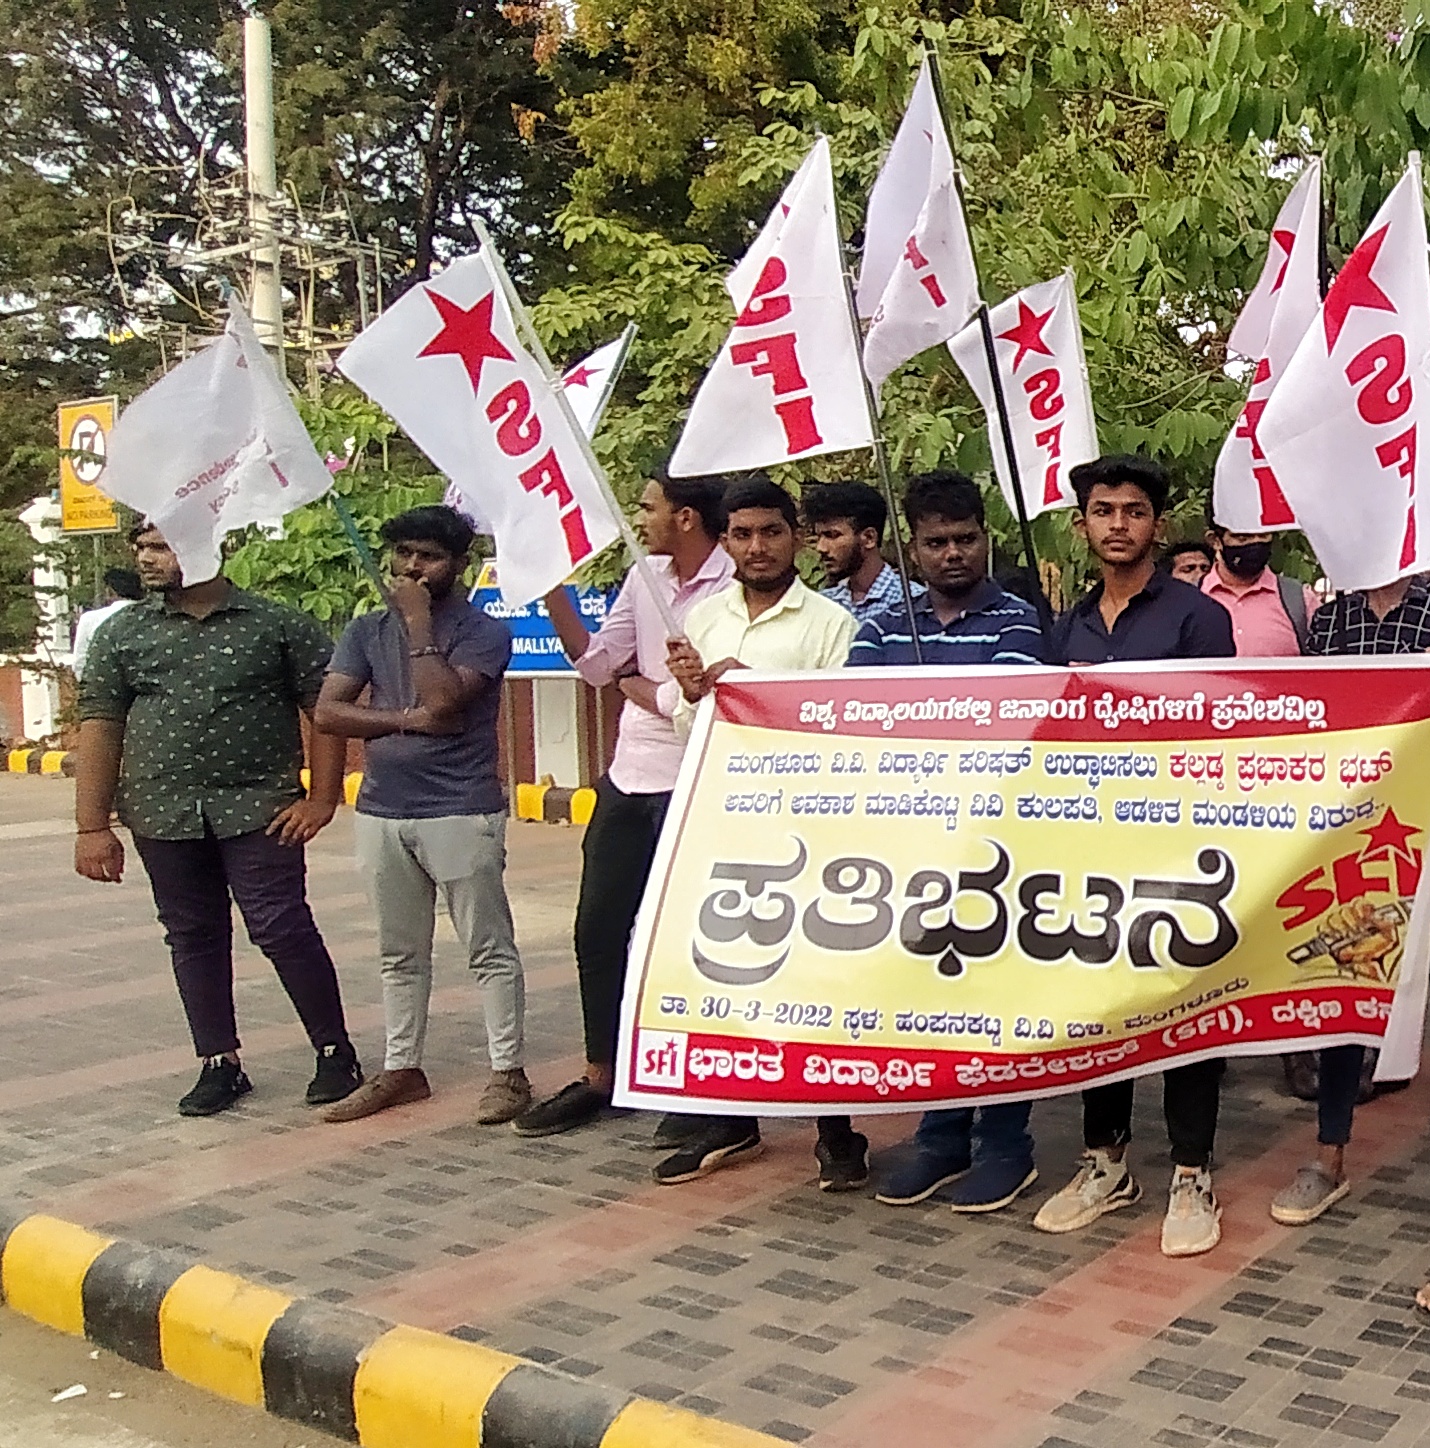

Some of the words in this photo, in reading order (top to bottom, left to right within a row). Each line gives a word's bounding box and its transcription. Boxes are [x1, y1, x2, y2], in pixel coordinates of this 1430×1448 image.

[512, 637, 564, 654] MALLYA
[799, 698, 837, 730] ವಿಶ್ವ
[843, 696, 992, 730] ವಿದ್ಯಾಲಯಗಳಲ್ಲಿ
[999, 696, 1086, 720] ಜನಾಂಗ
[1094, 692, 1205, 729] ದ್ವೇಷಿಗಳಿಗೆ
[1211, 692, 1327, 728] ಪ್ರವೇಶವಿಲ್ಲ
[727, 751, 821, 774] ಮಂಗಳೂರು
[878, 751, 949, 783] ವಿದ್ಯಾರ್ಥಿ
[958, 746, 1032, 778] ಪರಿಷತ್
[1237, 750, 1325, 791] ಪ್ರಭಾಕರ
[1340, 750, 1393, 788] ಭಟ್
[725, 788, 784, 814] ಅವರಿಗೆ
[791, 790, 857, 815] ಅವಕಾಶ
[865, 789, 960, 831] ಮಾಡಿಕೊಟ್ಟ
[1115, 796, 1182, 823] ಆಡಳಿತ
[1192, 798, 1296, 830] ಮಂಡಳಿಯ
[692, 835, 1239, 985] ಪ್ರತಿಭಟನೆ
[1276, 847, 1422, 931] SFI
[700, 996, 833, 1028] 30-3-2022
[643, 1047, 678, 1078] SFI
[688, 1045, 785, 1082] ಭಾರತ
[802, 1054, 936, 1096] ವಿದ್ಯಾರ್ಥಿ
[1271, 998, 1343, 1030] ದಕ್ಷಿಣ
